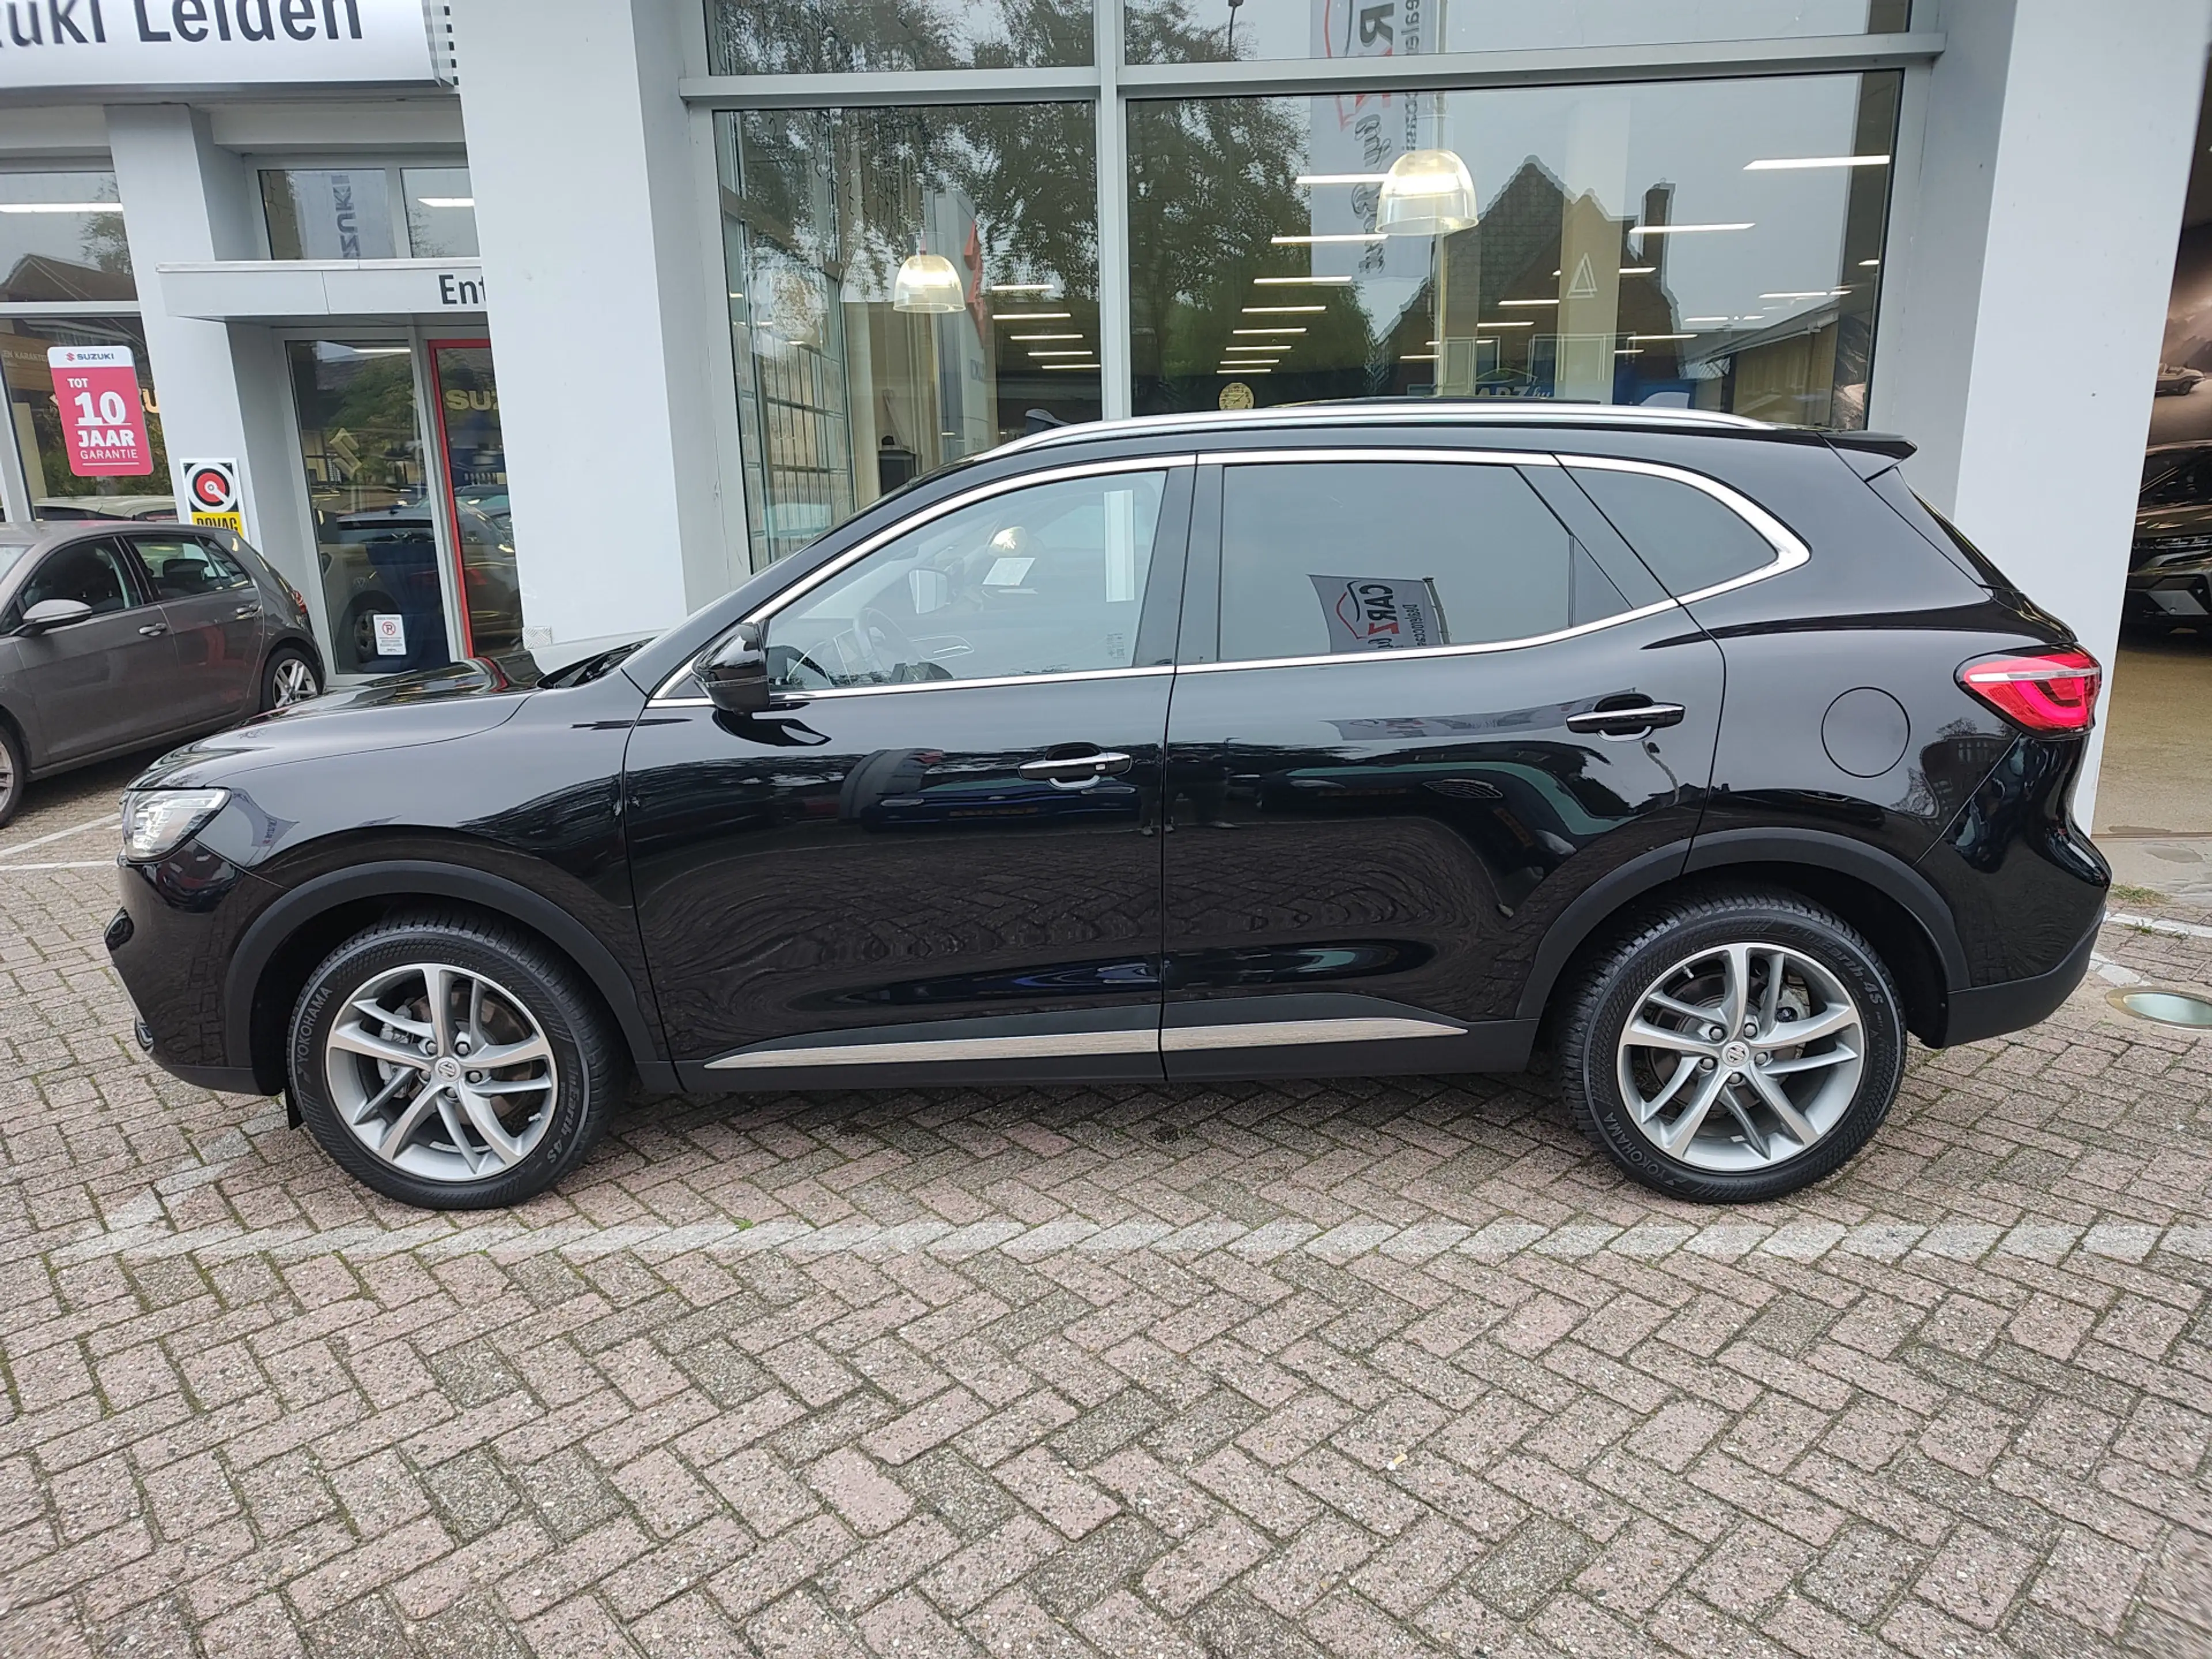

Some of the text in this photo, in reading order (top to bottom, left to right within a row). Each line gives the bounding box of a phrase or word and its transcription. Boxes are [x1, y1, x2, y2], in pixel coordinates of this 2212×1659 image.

[133, 0, 363, 42] Leiden
[67, 378, 89, 388] TOT
[74, 391, 126, 425] 10
[78, 429, 136, 447] JAAR
[80, 449, 139, 460] GARANTIE
[297, 986, 334, 1063] YOKOHAMA
[1603, 1111, 1667, 1180] YOKOHAMA
